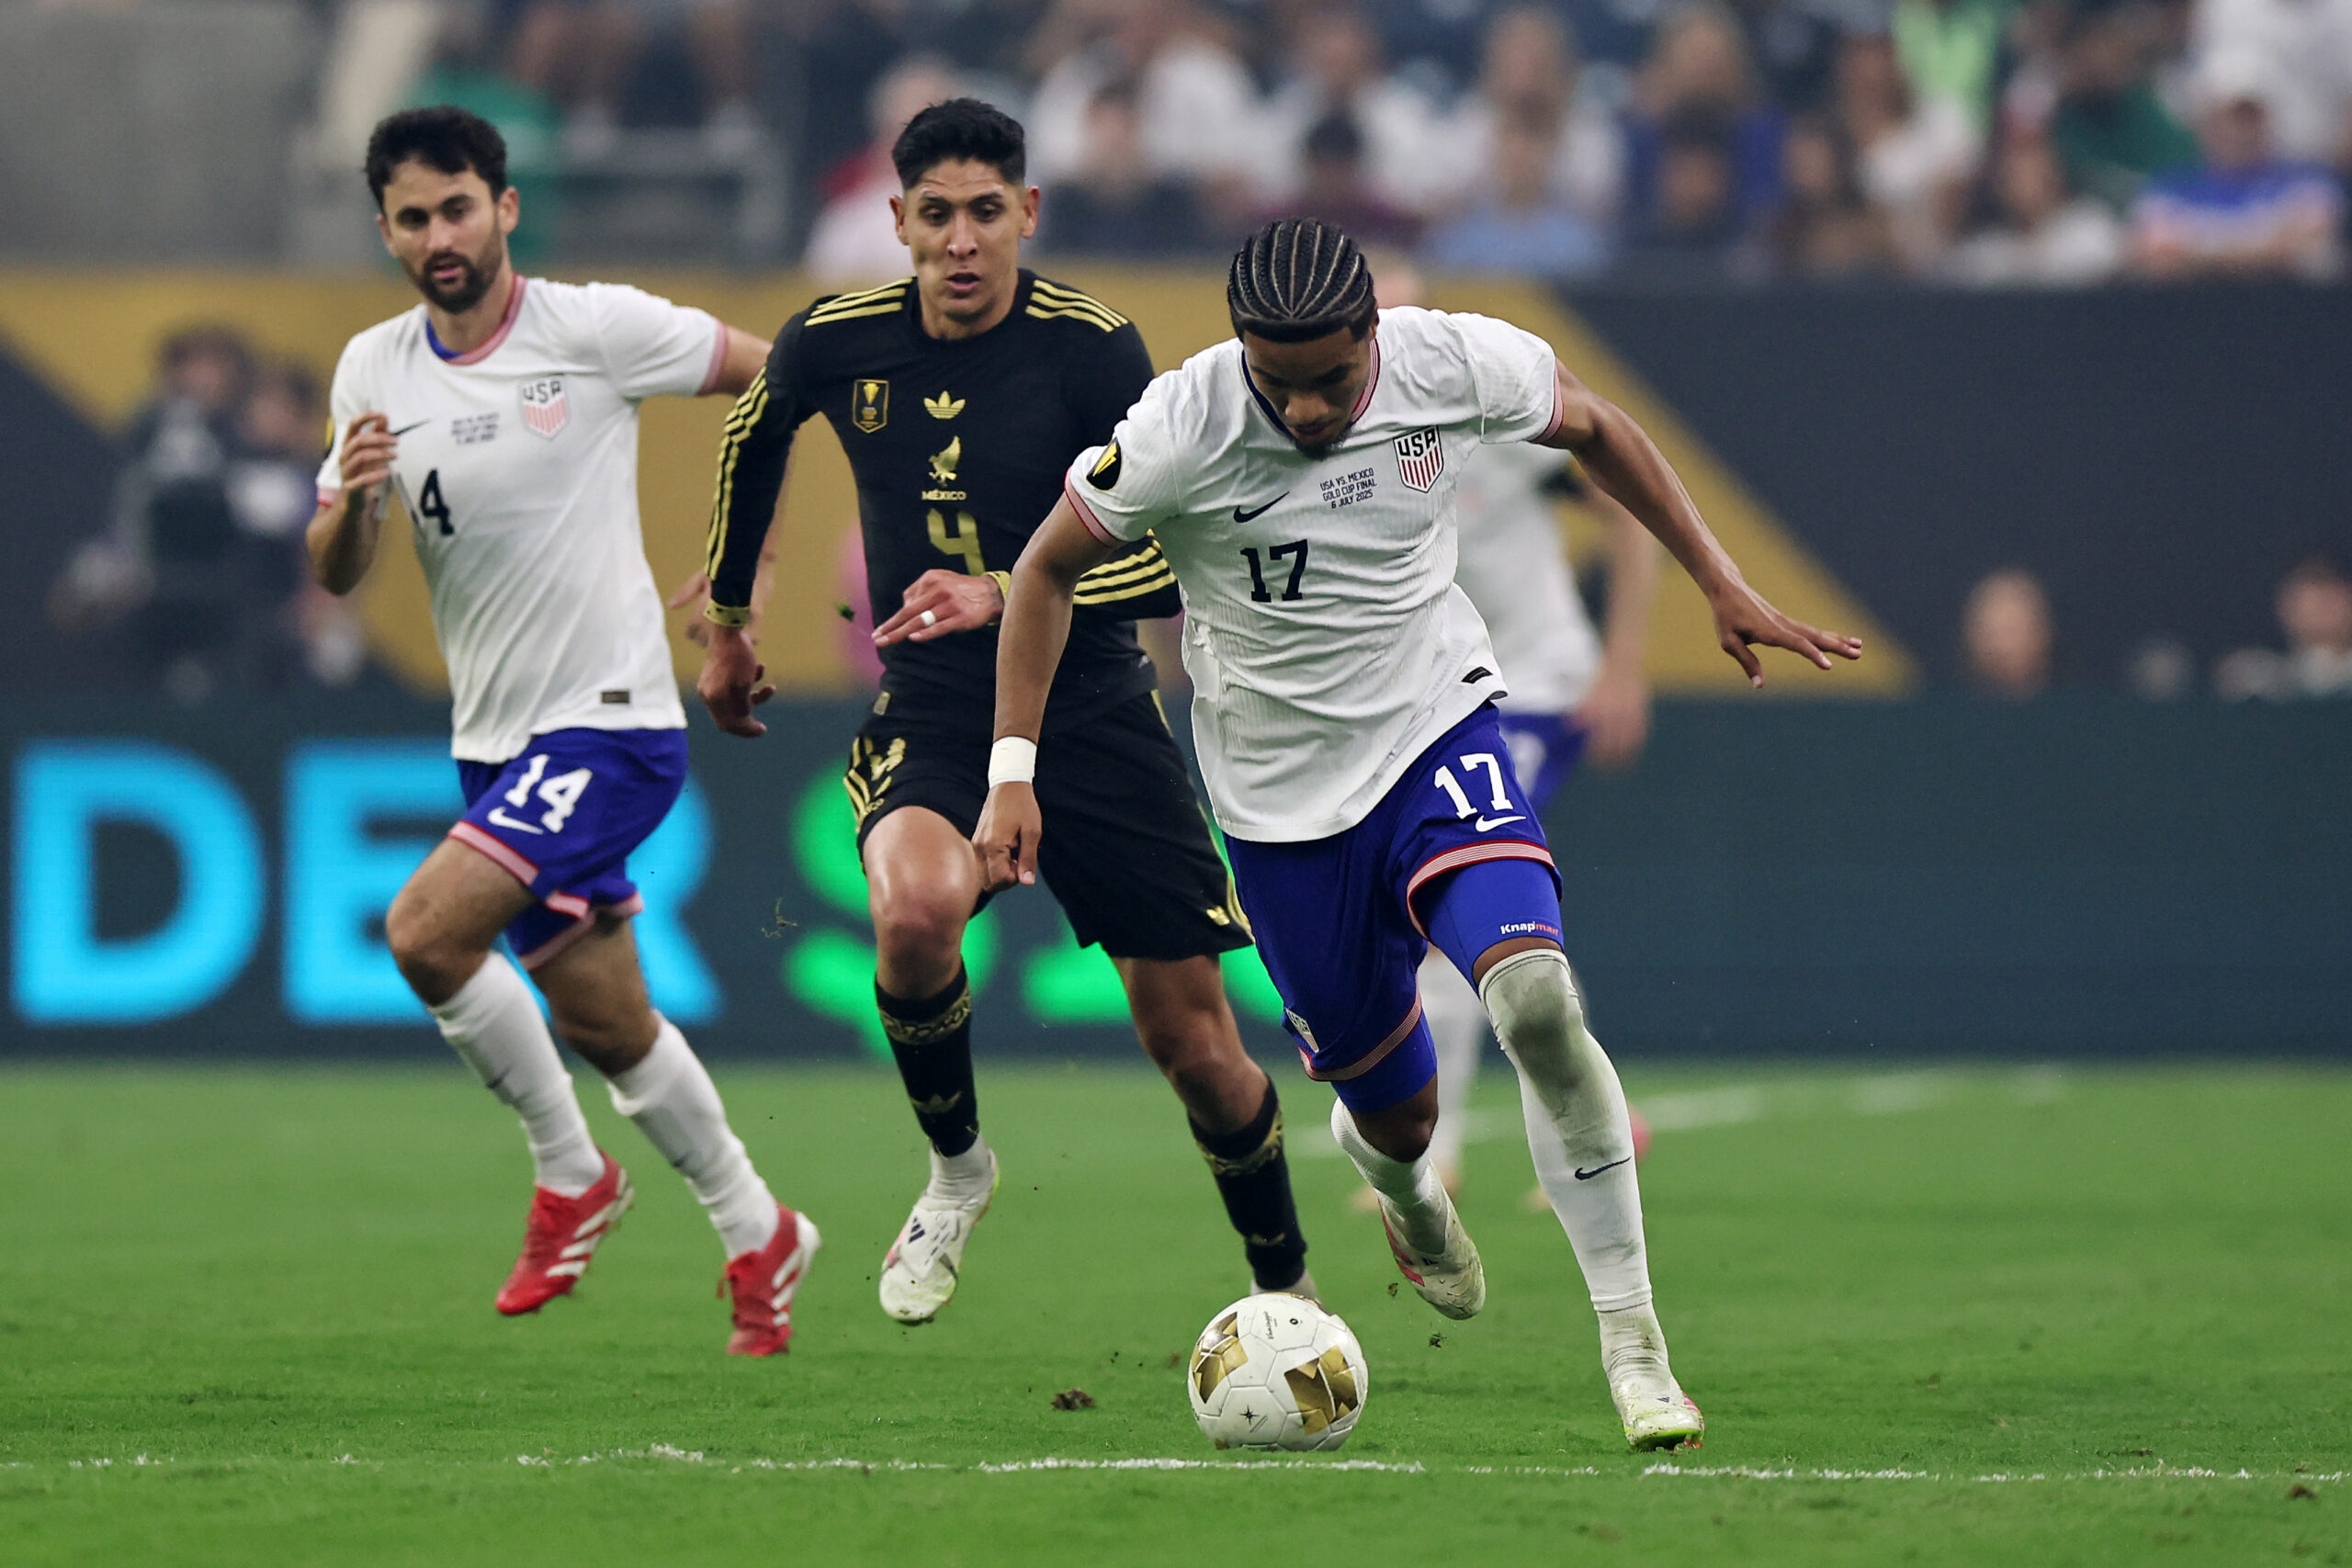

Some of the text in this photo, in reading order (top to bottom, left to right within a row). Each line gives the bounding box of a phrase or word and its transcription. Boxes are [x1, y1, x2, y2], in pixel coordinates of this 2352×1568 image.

[523, 380, 561, 403] USA
[1396, 428, 1436, 457] USA
[411, 468, 456, 536] 4
[1319, 467, 1374, 491] USA VS. MEXICO
[1322, 478, 1377, 502] GOLD CUP FINAL
[1330, 488, 1374, 509] 6 JULY 2025
[926, 507, 986, 577] 4
[1240, 539, 1308, 603] 17
[504, 753, 594, 834] 14
[1434, 752, 1514, 819] 17
